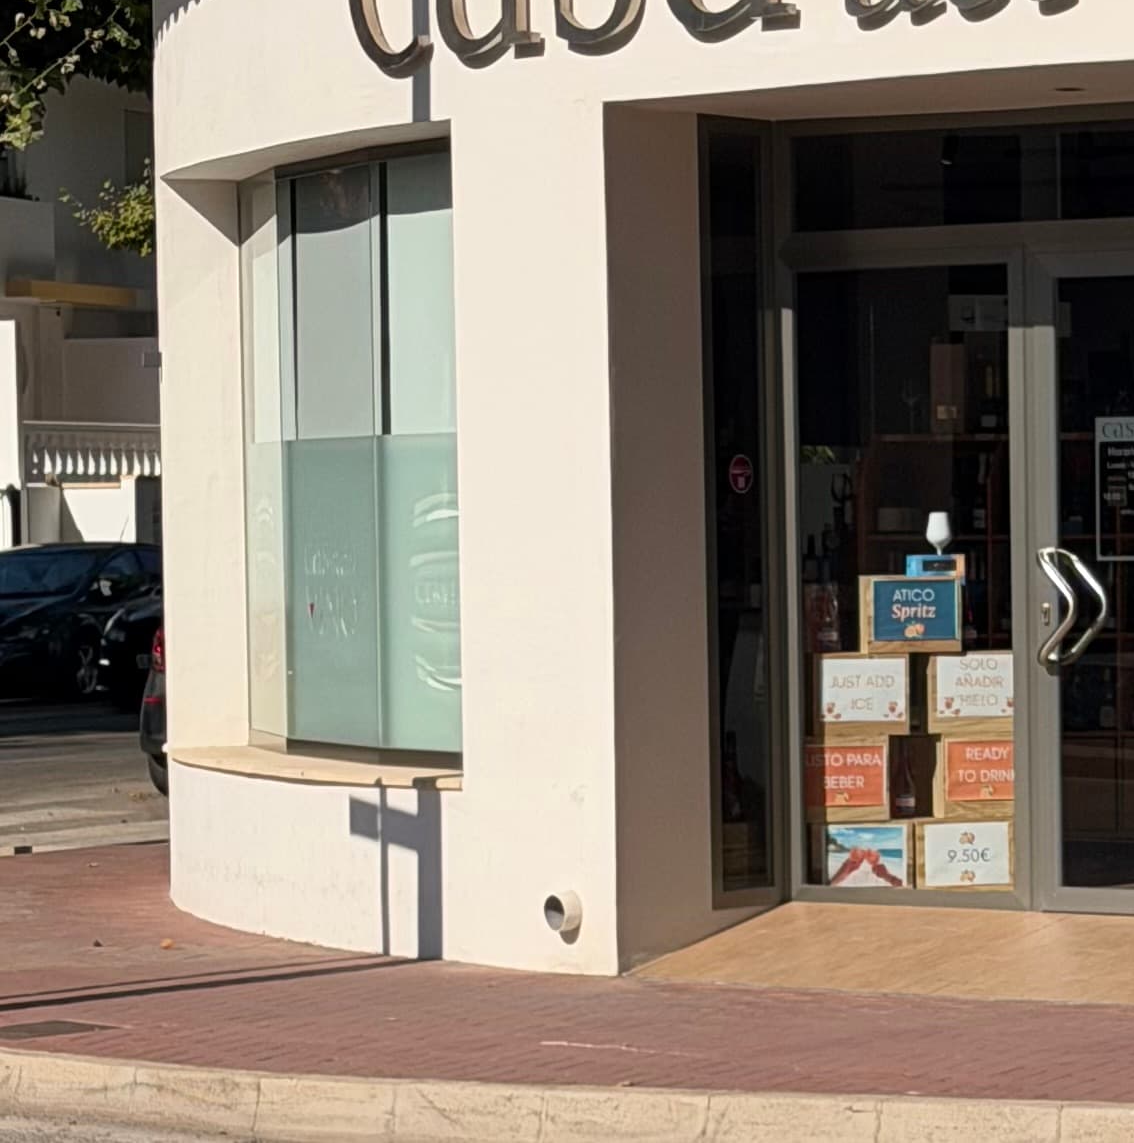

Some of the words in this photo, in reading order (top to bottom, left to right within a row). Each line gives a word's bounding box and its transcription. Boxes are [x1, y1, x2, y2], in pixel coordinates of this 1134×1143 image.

[892, 588, 935, 602] ATICO
[891, 603, 937, 622] Spritz
[959, 658, 998, 671] SOLO
[831, 674, 860, 689] JUST
[866, 674, 896, 688] ADD
[850, 697, 874, 711] ICE
[846, 752, 882, 767] PARA
[965, 746, 1010, 761] READY
[958, 769, 976, 783] TO
[980, 769, 1015, 783] DRIN
[946, 847, 992, 864] 9.50€
